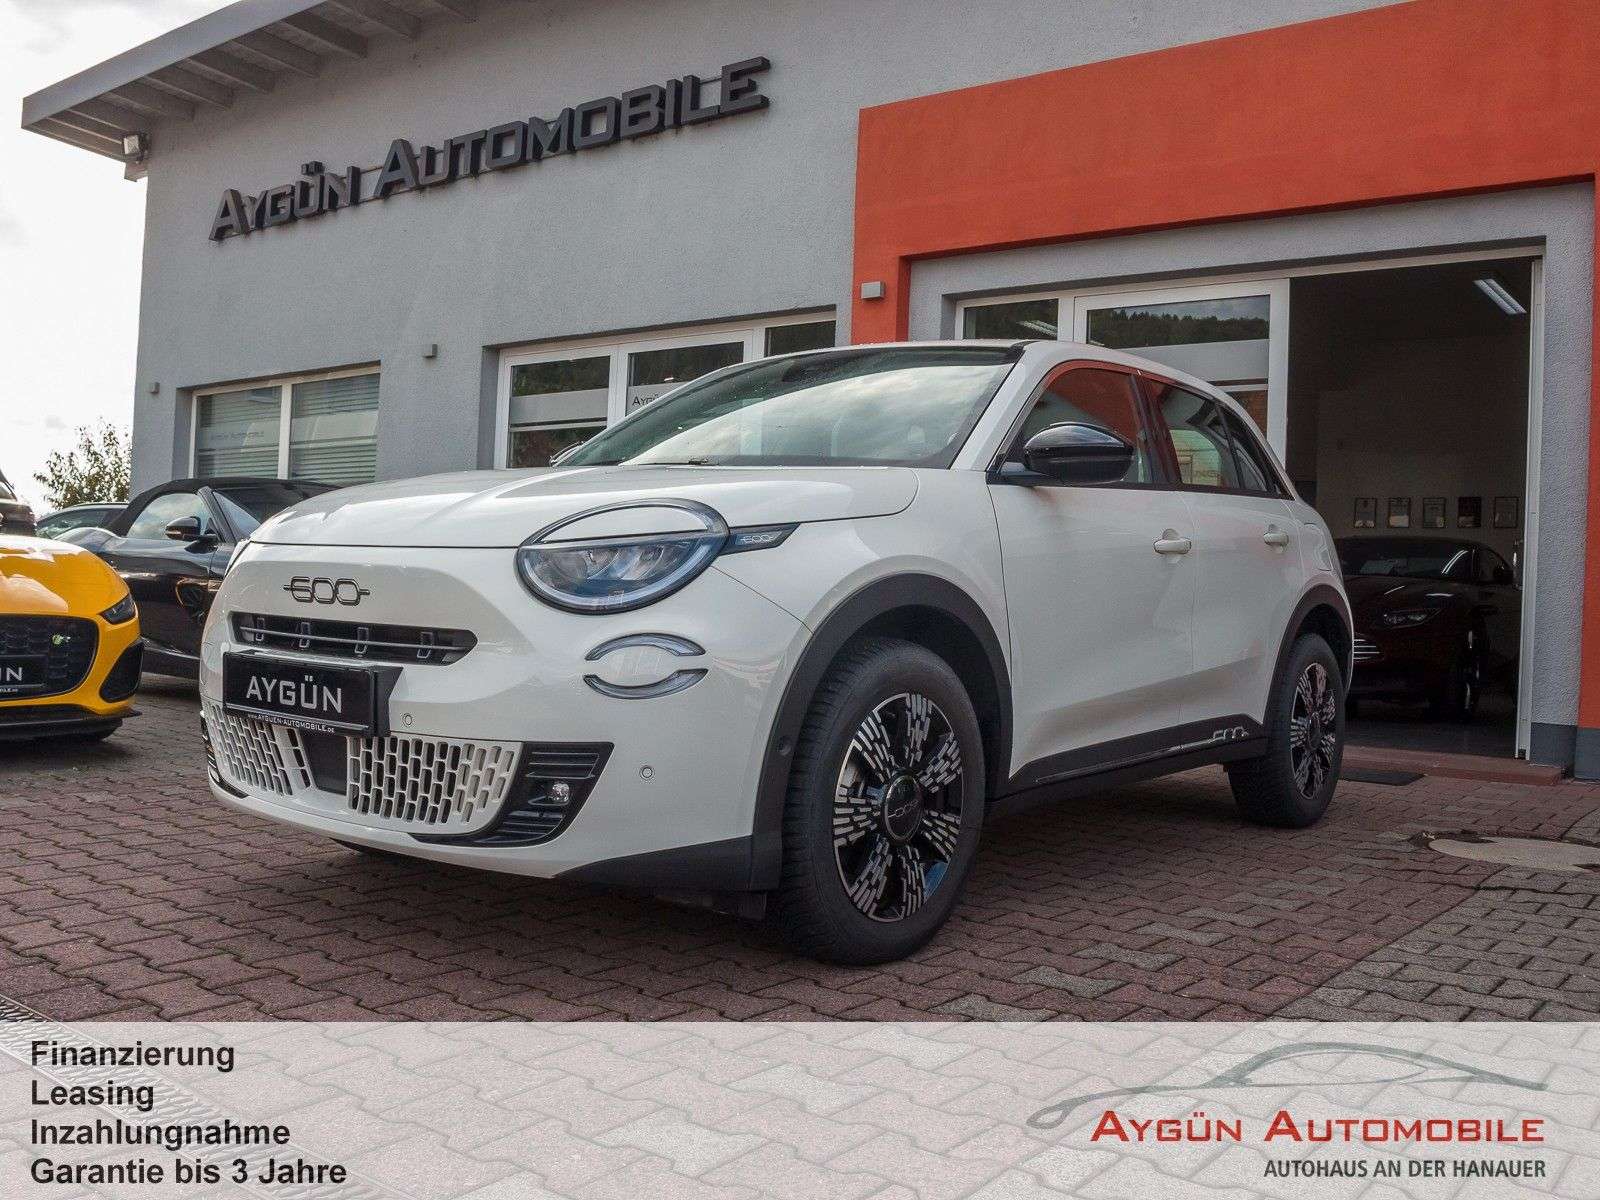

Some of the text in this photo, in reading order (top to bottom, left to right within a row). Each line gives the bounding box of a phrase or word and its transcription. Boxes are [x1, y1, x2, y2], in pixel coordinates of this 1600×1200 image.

[209, 56, 772, 241] AYGÜN AUTOMOBILE
[284, 576, 369, 607] 600
[246, 675, 343, 714] AYGÜN
